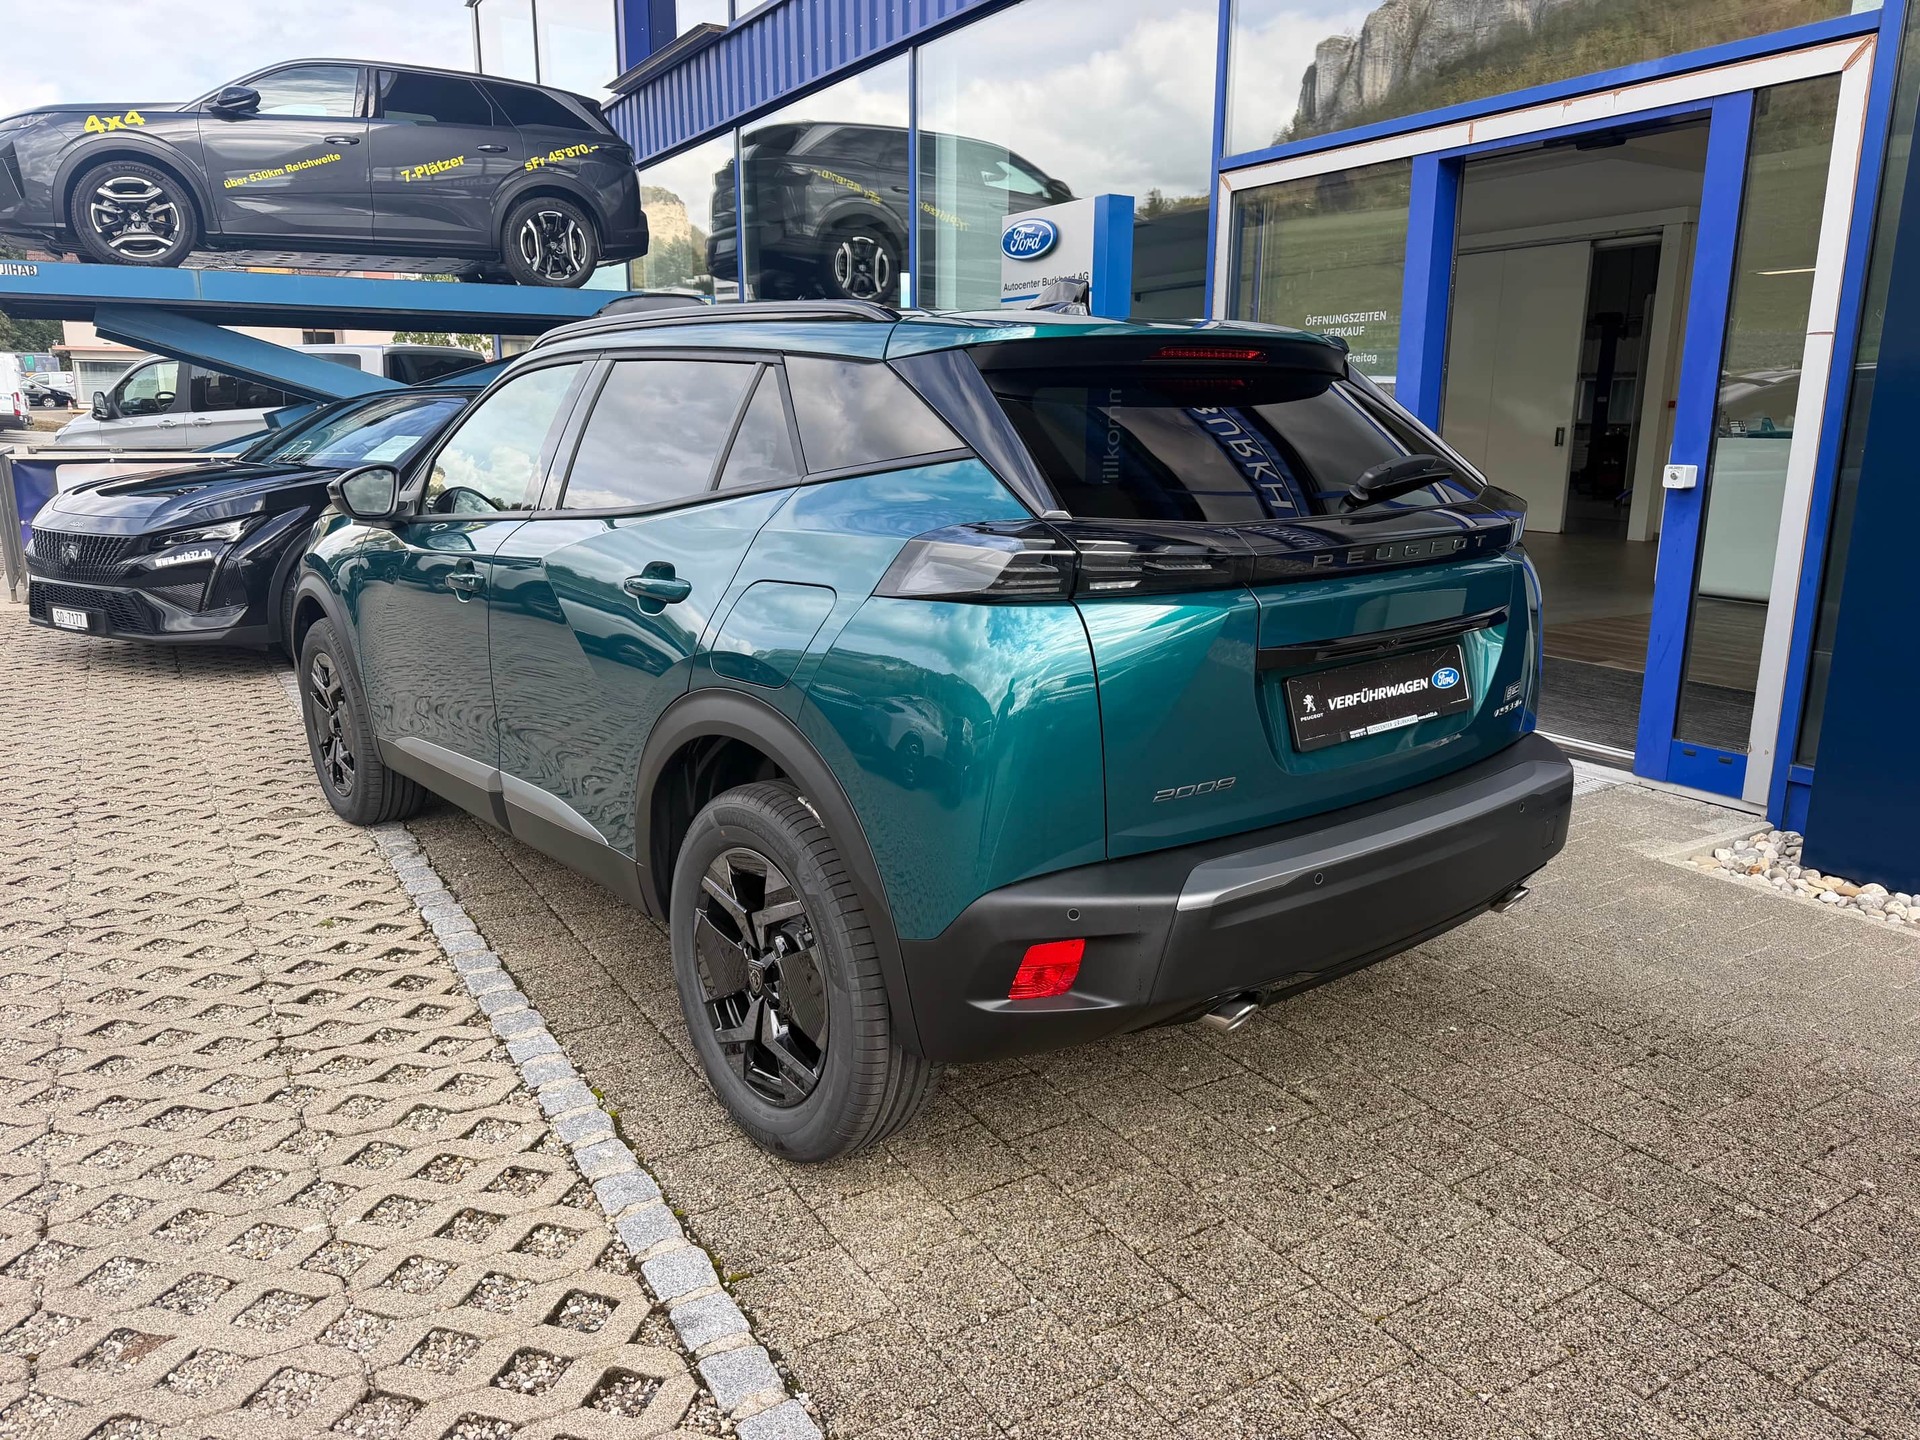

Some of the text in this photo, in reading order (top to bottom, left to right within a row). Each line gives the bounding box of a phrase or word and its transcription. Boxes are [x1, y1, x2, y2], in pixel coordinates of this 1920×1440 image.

[84, 110, 145, 133] 4x4
[224, 153, 341, 188] über 530km Reichweite
[401, 155, 465, 183] 7-Plätzer
[524, 155, 546, 172] sFr
[1010, 226, 1043, 252] Ford
[1003, 280, 1040, 291] Autocenter
[1078, 271, 1089, 281] AG
[1305, 310, 1387, 326] ÖFFNUNGSZEITEN
[1323, 326, 1365, 336] VERKAUF
[1347, 352, 1377, 363] Freitag
[1312, 535, 1487, 569] PEUGEOT
[1437, 671, 1454, 686] Ford
[1327, 677, 1428, 710] VERFÜHRWAGEN
[1300, 712, 1324, 722] PEUGEOT
[1153, 776, 1236, 803] 2008
